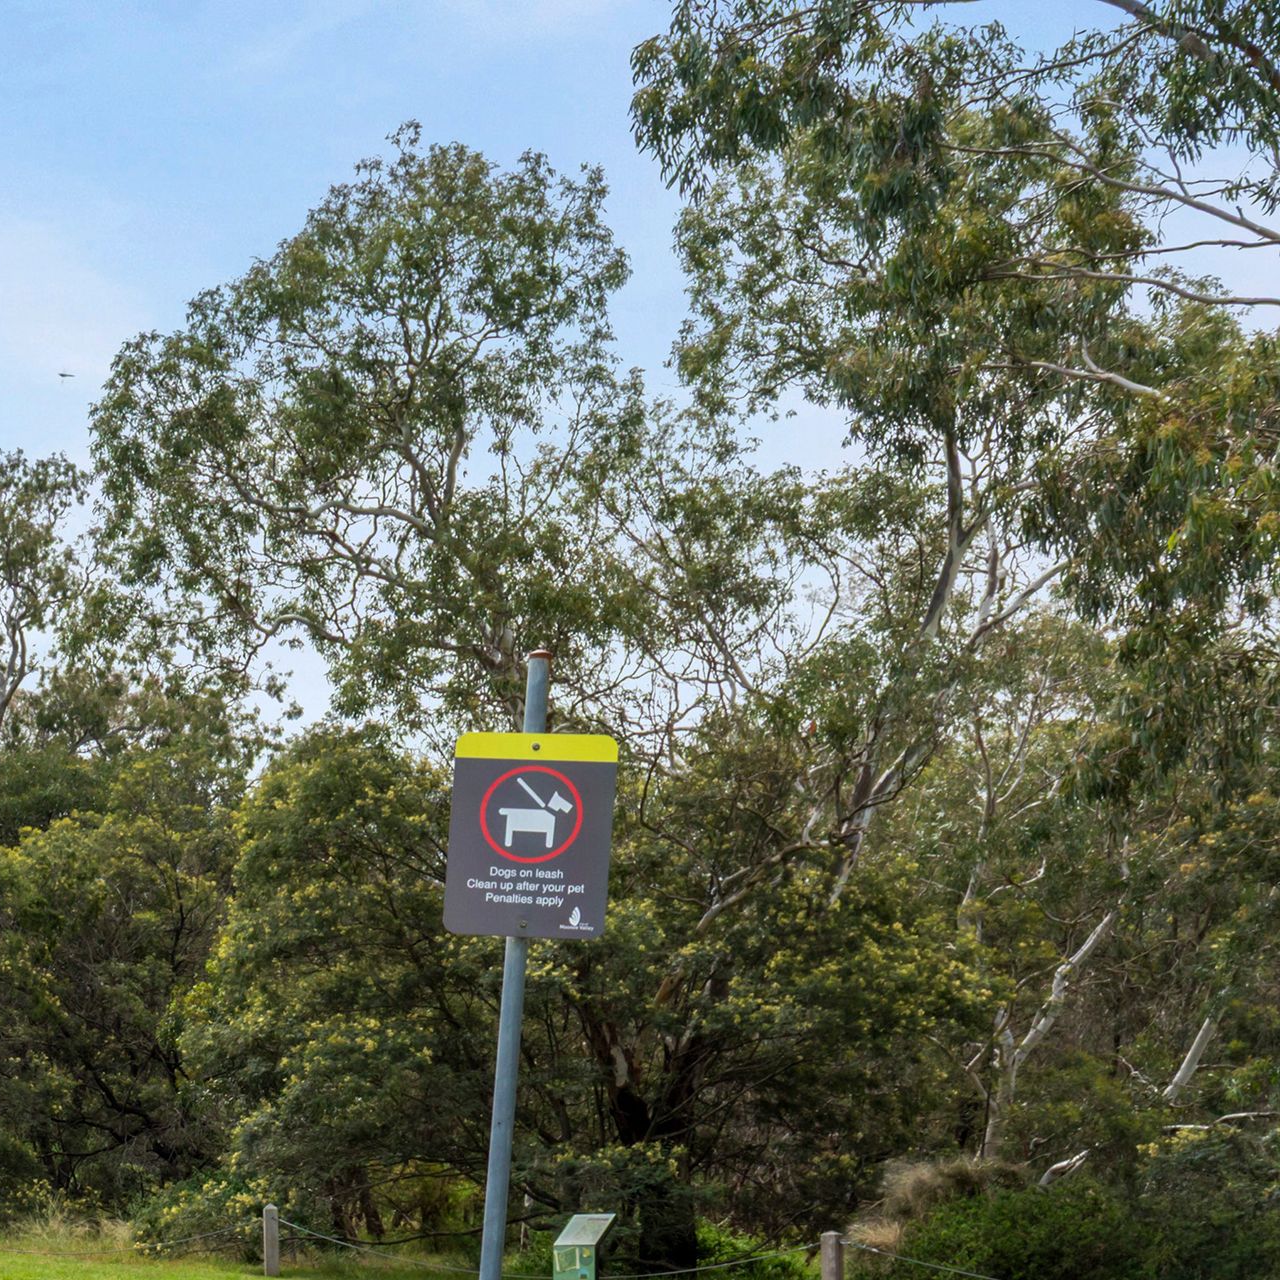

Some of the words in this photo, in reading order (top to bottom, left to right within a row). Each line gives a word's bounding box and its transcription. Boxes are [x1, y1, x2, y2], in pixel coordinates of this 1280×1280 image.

[489, 866, 517, 879] Dogs
[519, 870, 533, 878] on
[536, 868, 564, 879] leash
[466, 879, 497, 889] Clean
[500, 882, 514, 892] up
[516, 881, 539, 891] after
[542, 884, 565, 894] your
[567, 884, 585, 895] pet
[485, 892, 533, 904] Penalties
[535, 895, 564, 908] apply
